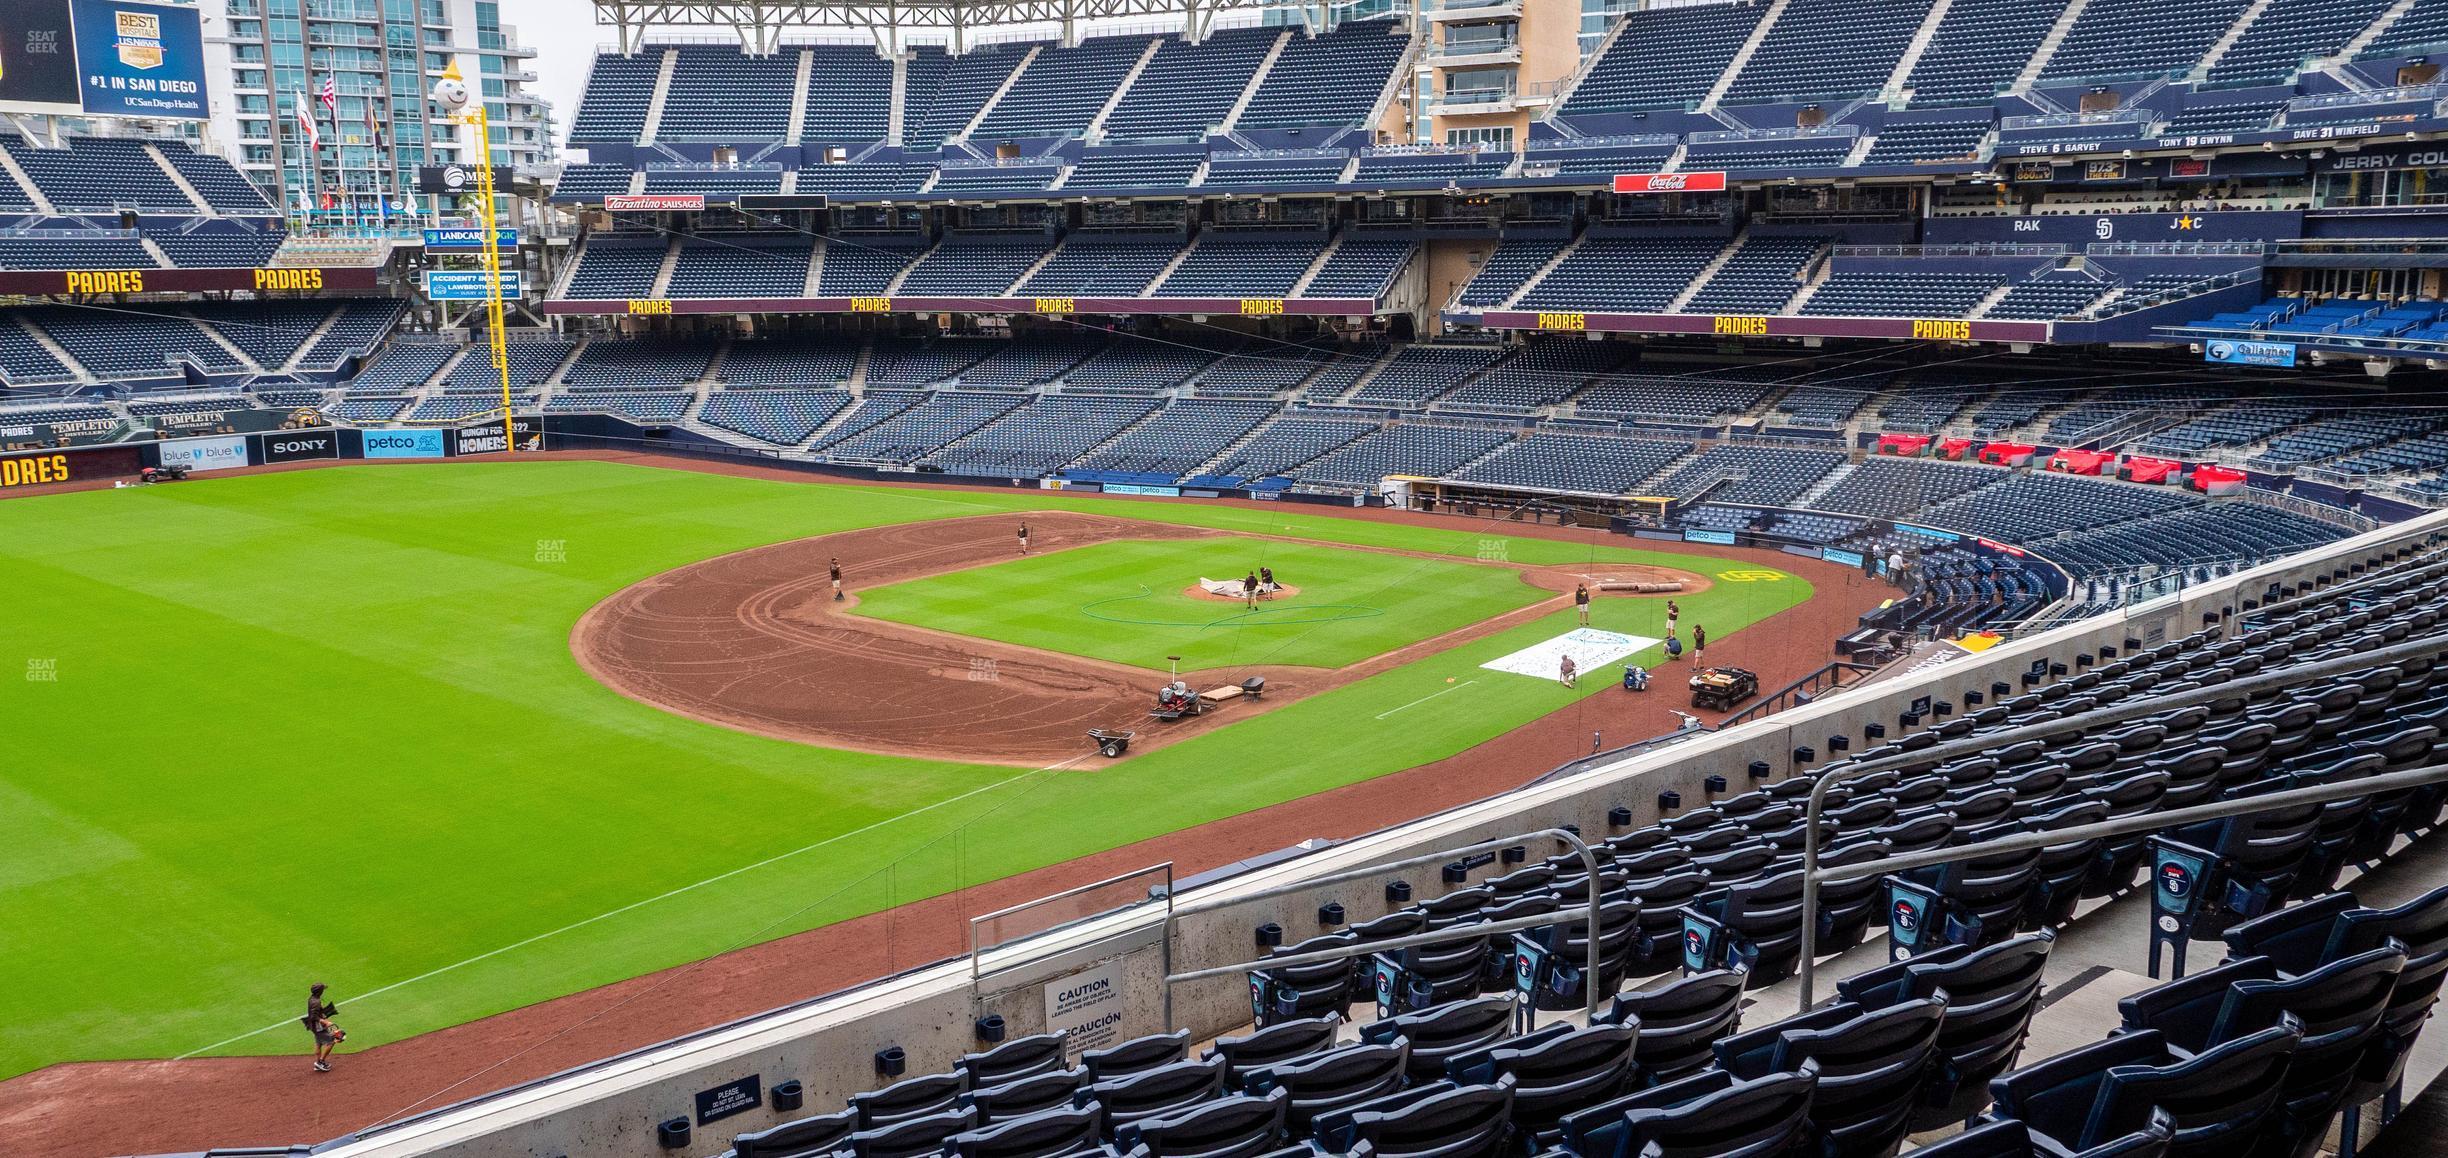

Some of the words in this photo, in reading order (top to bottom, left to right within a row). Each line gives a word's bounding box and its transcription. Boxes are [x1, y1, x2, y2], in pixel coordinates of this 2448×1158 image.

[119, 14, 156, 29] BEST
[119, 27, 158, 38] HOSPITALS
[90, 75, 107, 89] #1
[111, 77, 125, 90] IN
[129, 79, 156, 92] SAN
[159, 80, 197, 94] DIEGO
[124, 97, 138, 106] UC
[138, 98, 153, 107] San
[153, 98, 174, 110] Diego
[174, 99, 199, 109] Health
[2294, 129, 2317, 139] DAVE
[2320, 127, 2333, 138] 31
[2334, 125, 2381, 137] WINFIELD
[2159, 138, 2181, 147] TONY
[2185, 136, 2198, 146] 19
[2200, 135, 2233, 145] GWYNN
[2020, 145, 2048, 154] STEVE
[2052, 144, 2060, 153] 6
[2065, 143, 2101, 152] GARVEY
[2332, 154, 2399, 170] JERRY
[608, 197, 661, 209] Tarantino
[662, 200, 703, 209] SAUSAGES
[2014, 220, 2040, 231] RAK
[440, 231, 485, 242] LANDCARE
[66, 270, 143, 293] PADRES
[254, 269, 323, 289] PADRES
[432, 275, 476, 283] ACCIDENT?
[629, 300, 672, 314] PADRES
[851, 298, 891, 312] PADRES
[1036, 298, 1074, 312] PADRES
[1241, 299, 1283, 314] PADRES
[1539, 313, 1585, 330] PADRES
[1714, 316, 1767, 334] PADRES
[1913, 320, 1971, 339] PADRES
[2238, 344, 2292, 358] Gallagher
[161, 412, 225, 426] TEMPLETON
[174, 421, 213, 429] DISTILLERY
[1, 427, 33, 437] PADRES
[51, 419, 119, 435] TEMPLETON
[461, 427, 489, 438] HUNGRY
[490, 426, 503, 436] FOR
[273, 439, 328, 454] SONY
[368, 436, 414, 452] petco
[459, 436, 508, 453] HOMERS
[163, 449, 190, 462] blue
[206, 446, 232, 457] blue
[0, 454, 68, 486] DRES
[1104, 485, 1122, 493] petco
[1687, 530, 1709, 540] petco
[1058, 978, 1109, 1002] CAUTION
[1051, 1007, 1072, 1018] LEAVING
[1073, 1003, 1082, 1011] THE
[1083, 999, 1097, 1008] FIELD
[1105, 993, 1117, 1002] PLAY
[1065, 999, 1082, 1008] AWARE
[1090, 989, 1111, 999] OBJECTS
[1066, 1011, 1121, 1039] ECAUCIÓN
[1096, 1038, 1111, 1047] JUEGO
[718, 1086, 739, 1100] PLEASE
[735, 1093, 746, 1101] LEAN
